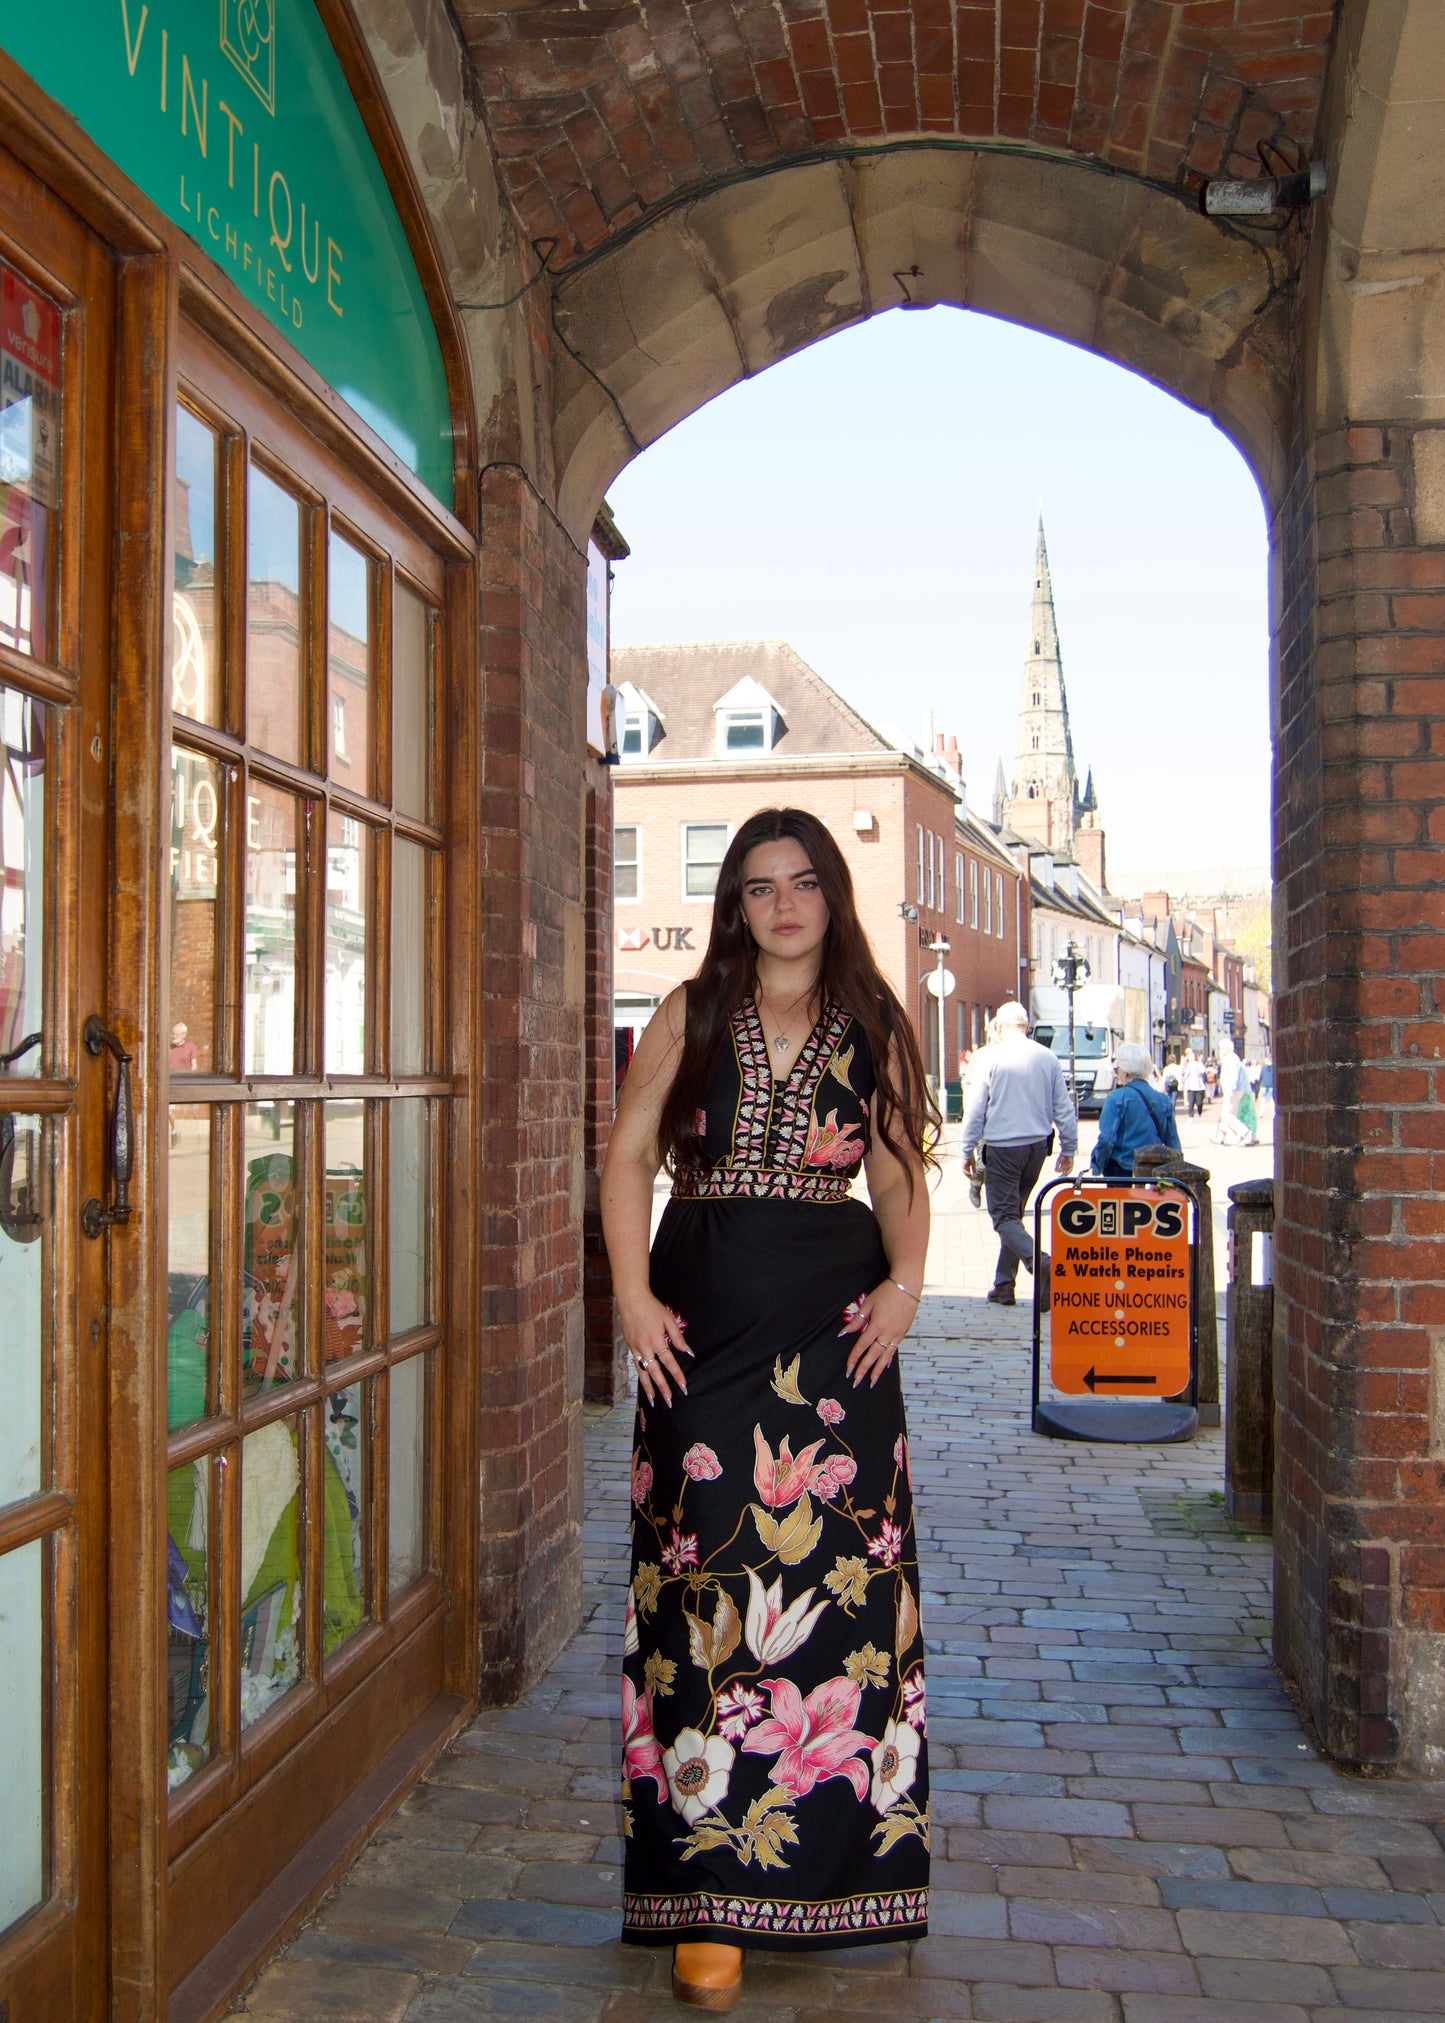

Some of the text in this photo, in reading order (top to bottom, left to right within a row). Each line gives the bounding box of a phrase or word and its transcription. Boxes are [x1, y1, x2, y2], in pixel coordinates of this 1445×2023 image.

[121, 0, 344, 317] VINTIQUE
[179, 174, 304, 329] LICHFIELD
[7, 328, 54, 373] verisure
[651, 926, 696, 951] UK
[1058, 1199, 1185, 1238] GIPS
[1066, 1246, 1173, 1262] Mobile Phone
[1054, 1263, 1185, 1281] & Watch Repairs
[1054, 1292, 1187, 1309] PHONE UNLOCKING
[1068, 1320, 1170, 1336] ACCESSORIES
